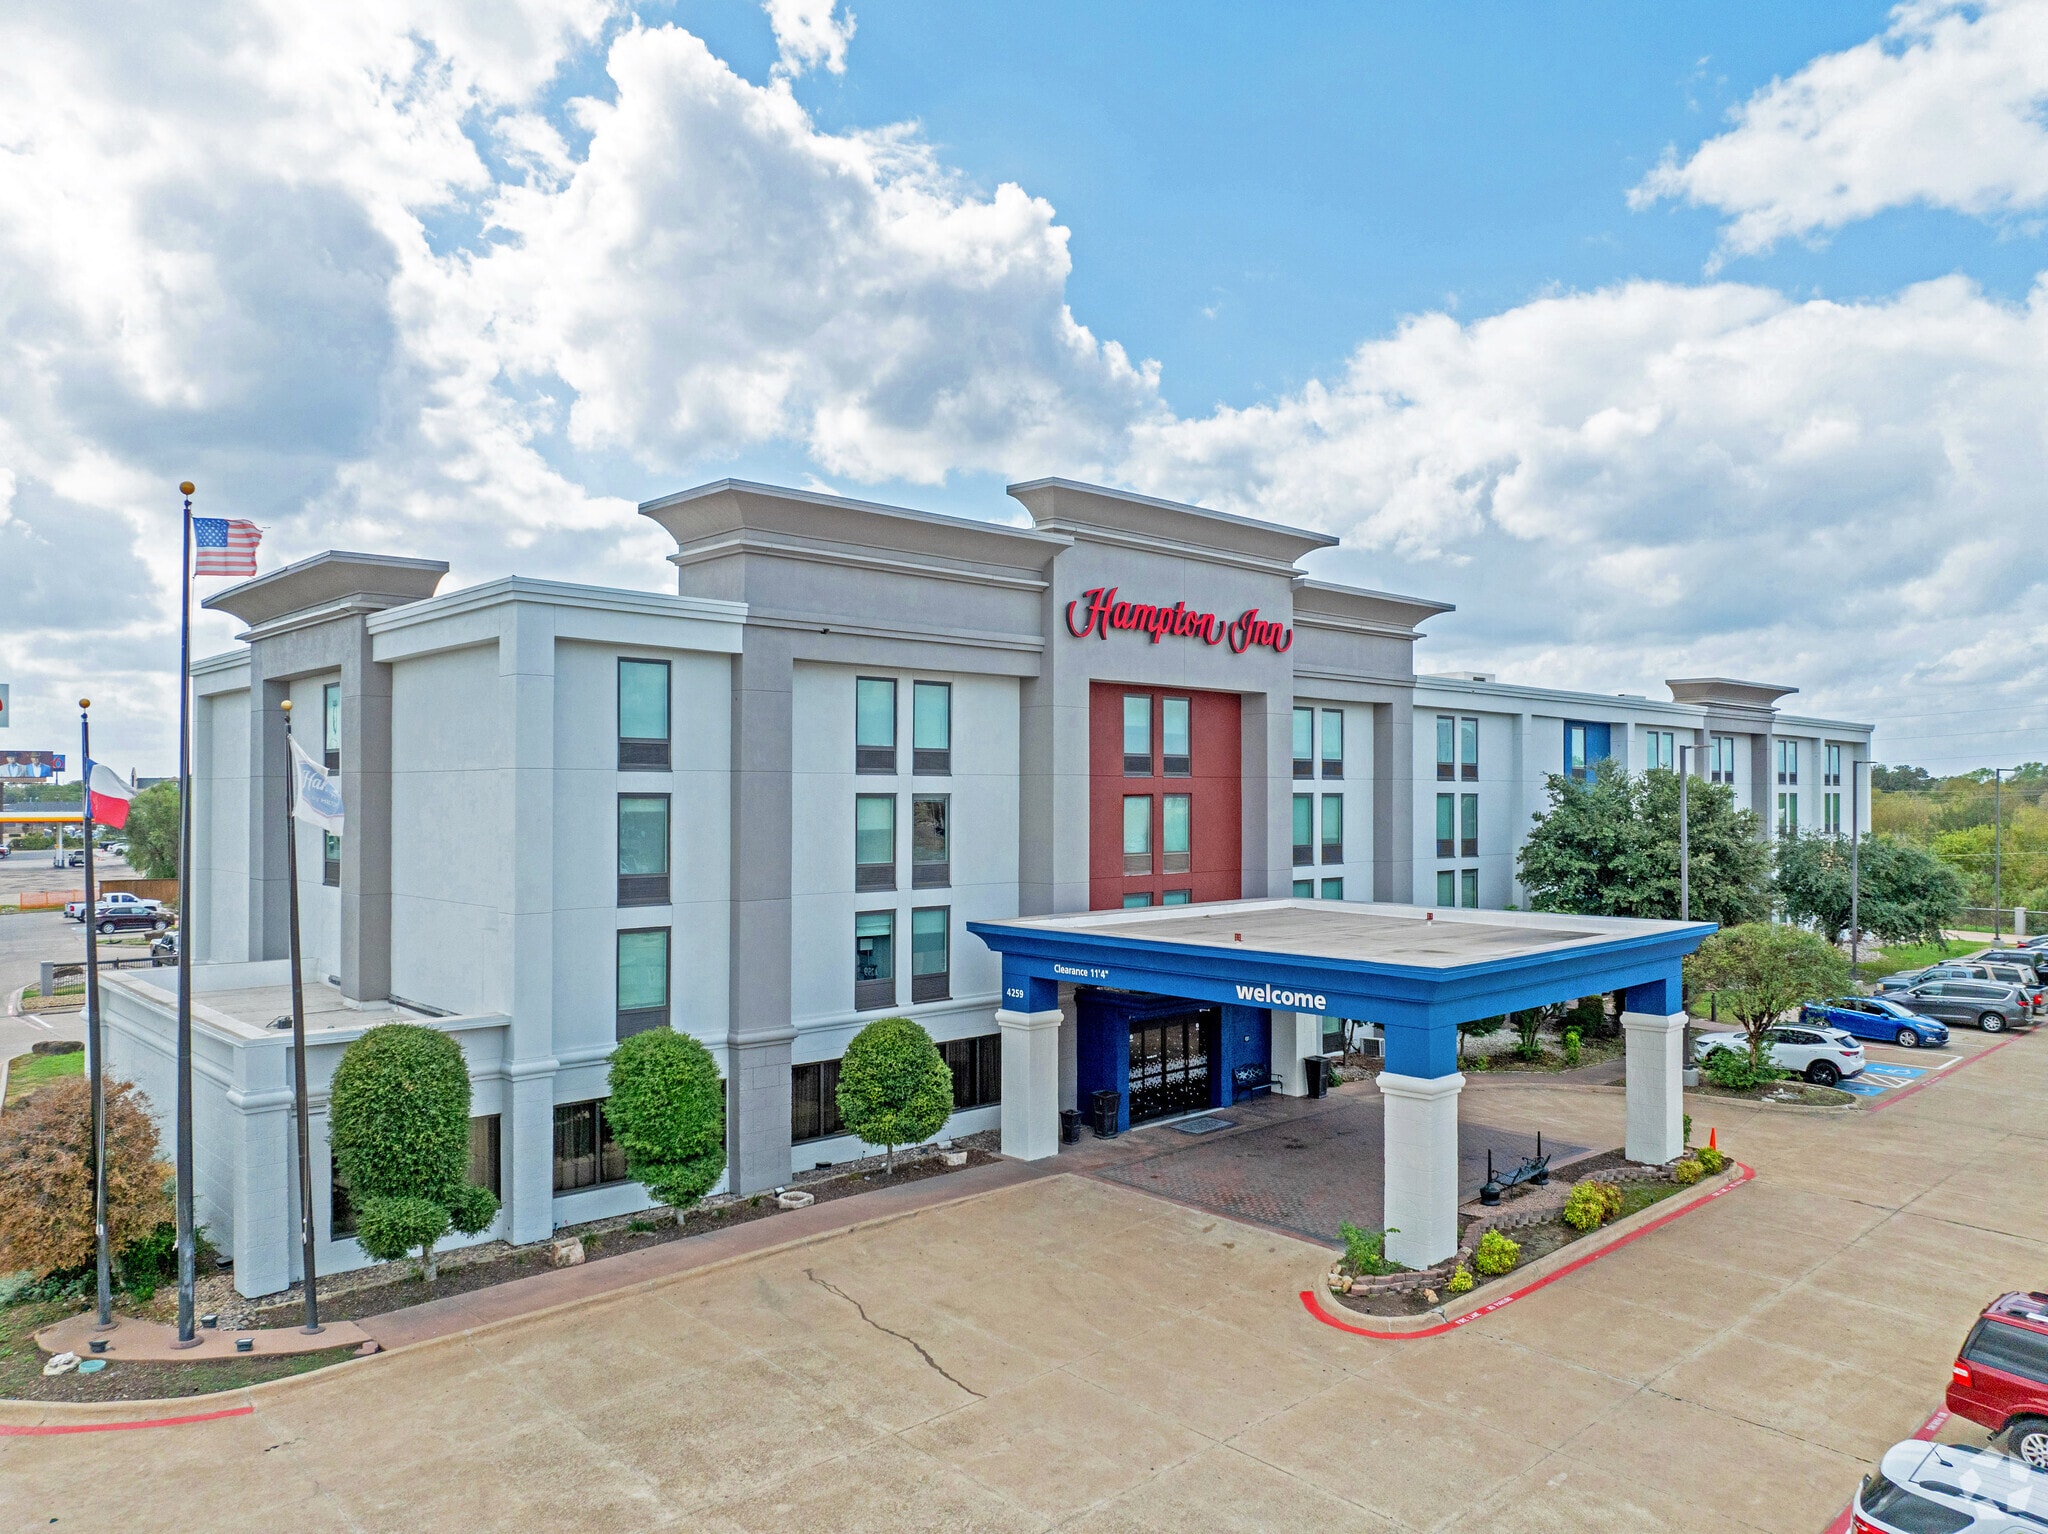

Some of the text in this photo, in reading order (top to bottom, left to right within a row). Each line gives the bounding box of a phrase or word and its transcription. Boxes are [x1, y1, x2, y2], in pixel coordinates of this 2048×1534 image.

[1066, 586, 1293, 654] Hampton Inn
[1054, 964, 1109, 979] Clearance 11'4"
[1006, 987, 1024, 999] 4259
[1235, 983, 1327, 1010] welcome
